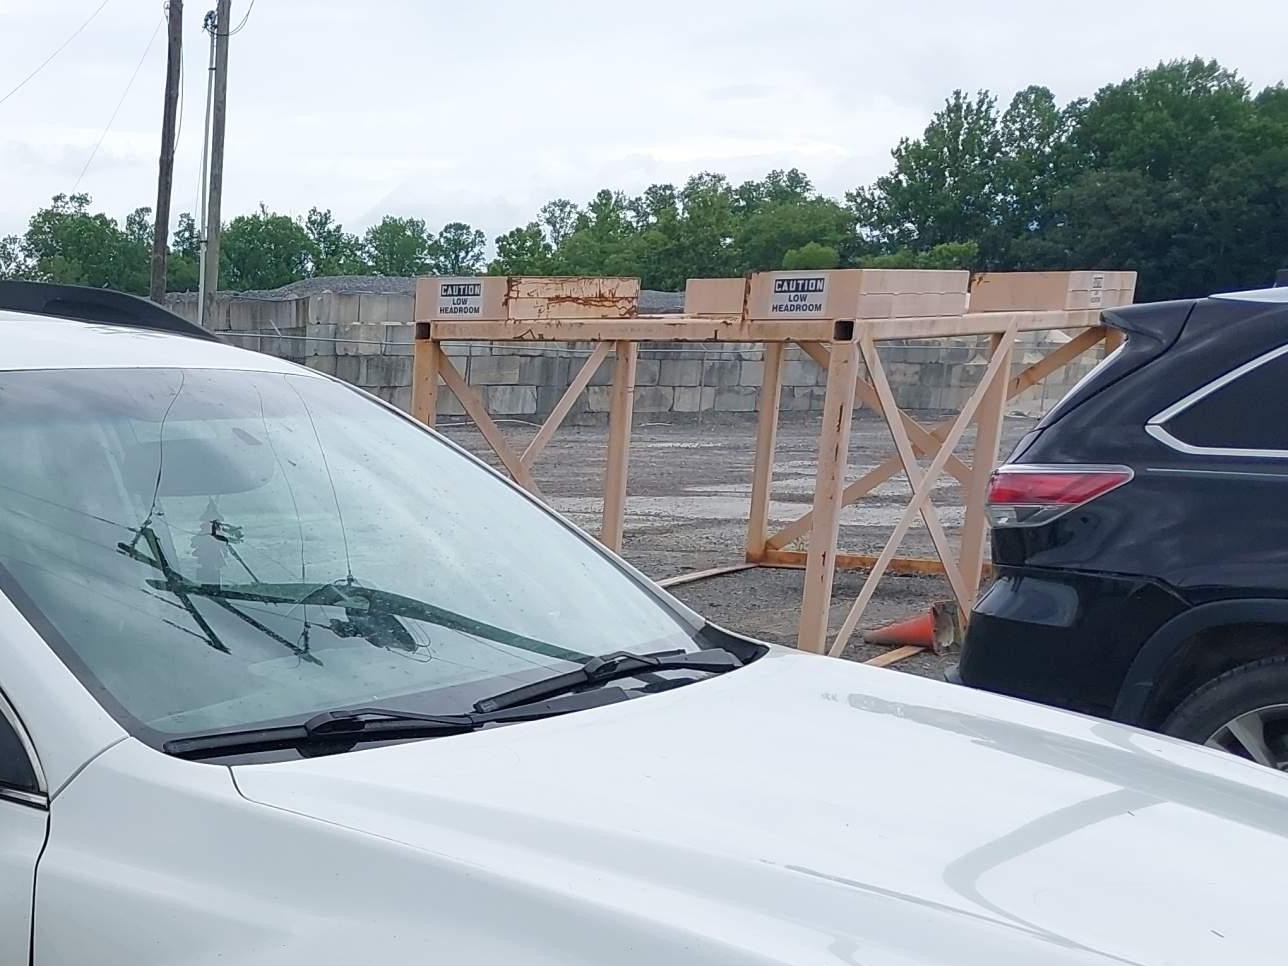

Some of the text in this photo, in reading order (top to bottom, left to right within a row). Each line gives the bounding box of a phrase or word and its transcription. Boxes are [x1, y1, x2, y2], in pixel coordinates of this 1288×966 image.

[775, 279, 824, 292] CAUTION
[441, 285, 481, 296] CAUTION
[788, 294, 807, 302] LOW
[439, 306, 480, 314] HEADROOM
[772, 303, 822, 312] HEADROOM
